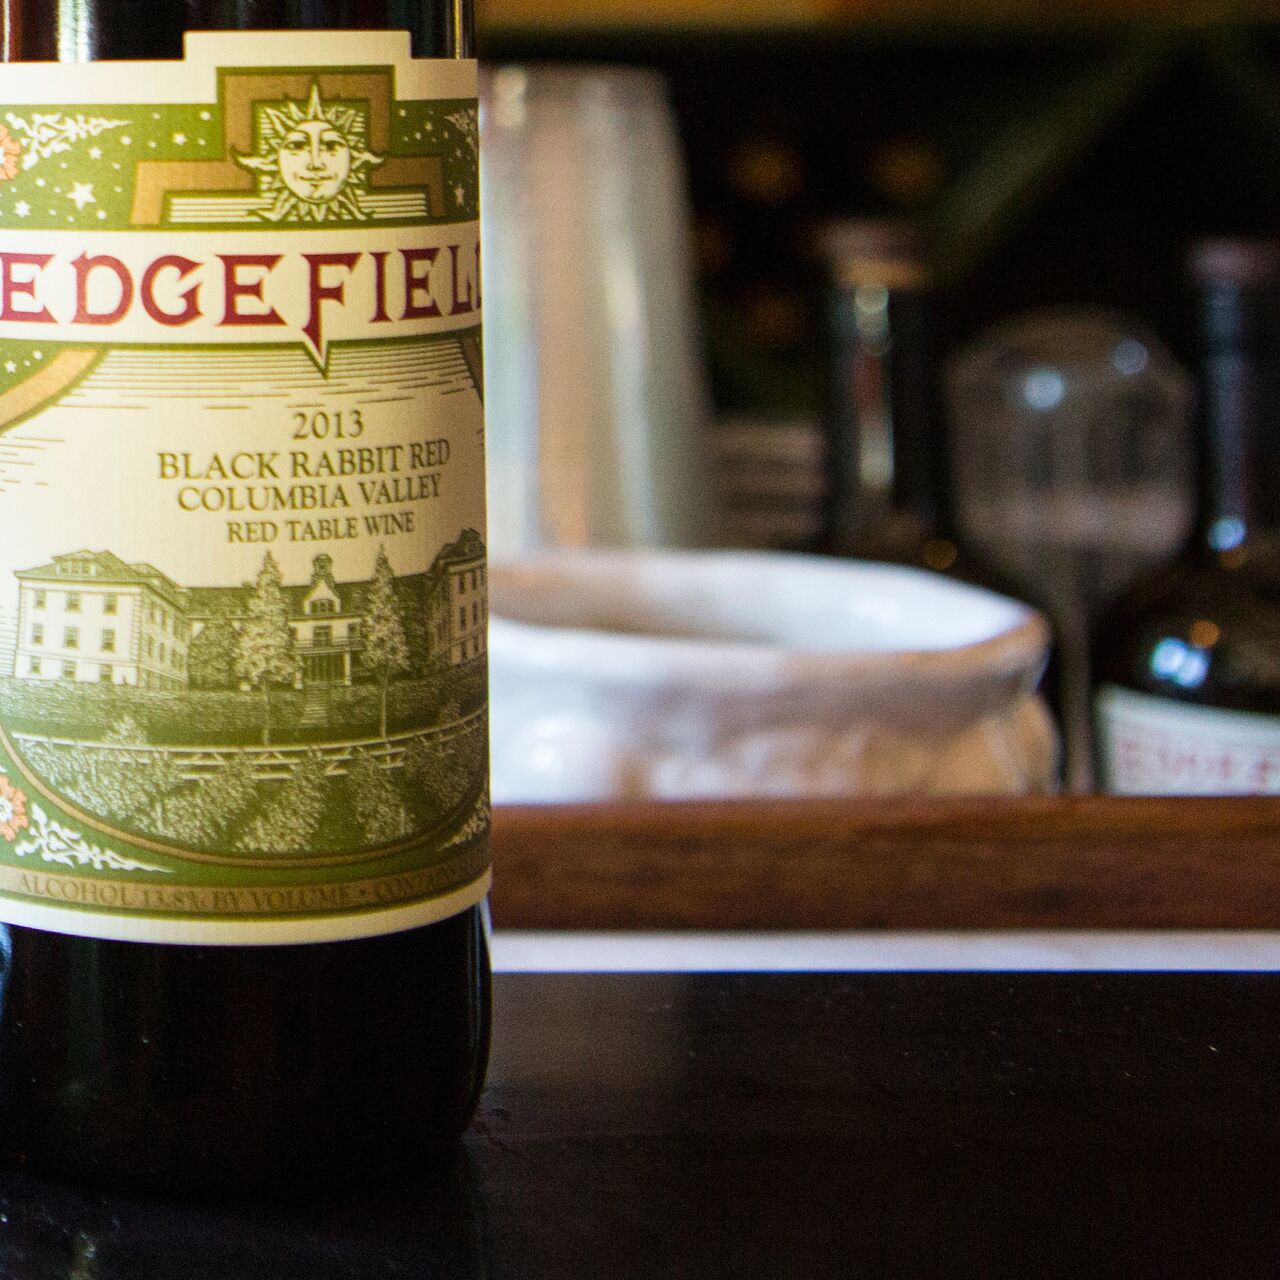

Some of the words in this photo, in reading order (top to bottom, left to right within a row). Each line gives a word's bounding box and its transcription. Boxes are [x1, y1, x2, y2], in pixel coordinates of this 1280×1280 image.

[292, 409, 365, 441] 2013
[156, 451, 281, 481] BLACK
[288, 444, 404, 479] RABBIT
[409, 437, 451, 470] RED
[176, 481, 352, 513] COLUMBIA
[358, 472, 442, 506] VALLEY
[226, 521, 279, 544] RED
[285, 517, 359, 543] TABLE
[362, 511, 415, 537] WINE
[17, 871, 134, 907] ALCOHOL
[211, 889, 243, 913] BY
